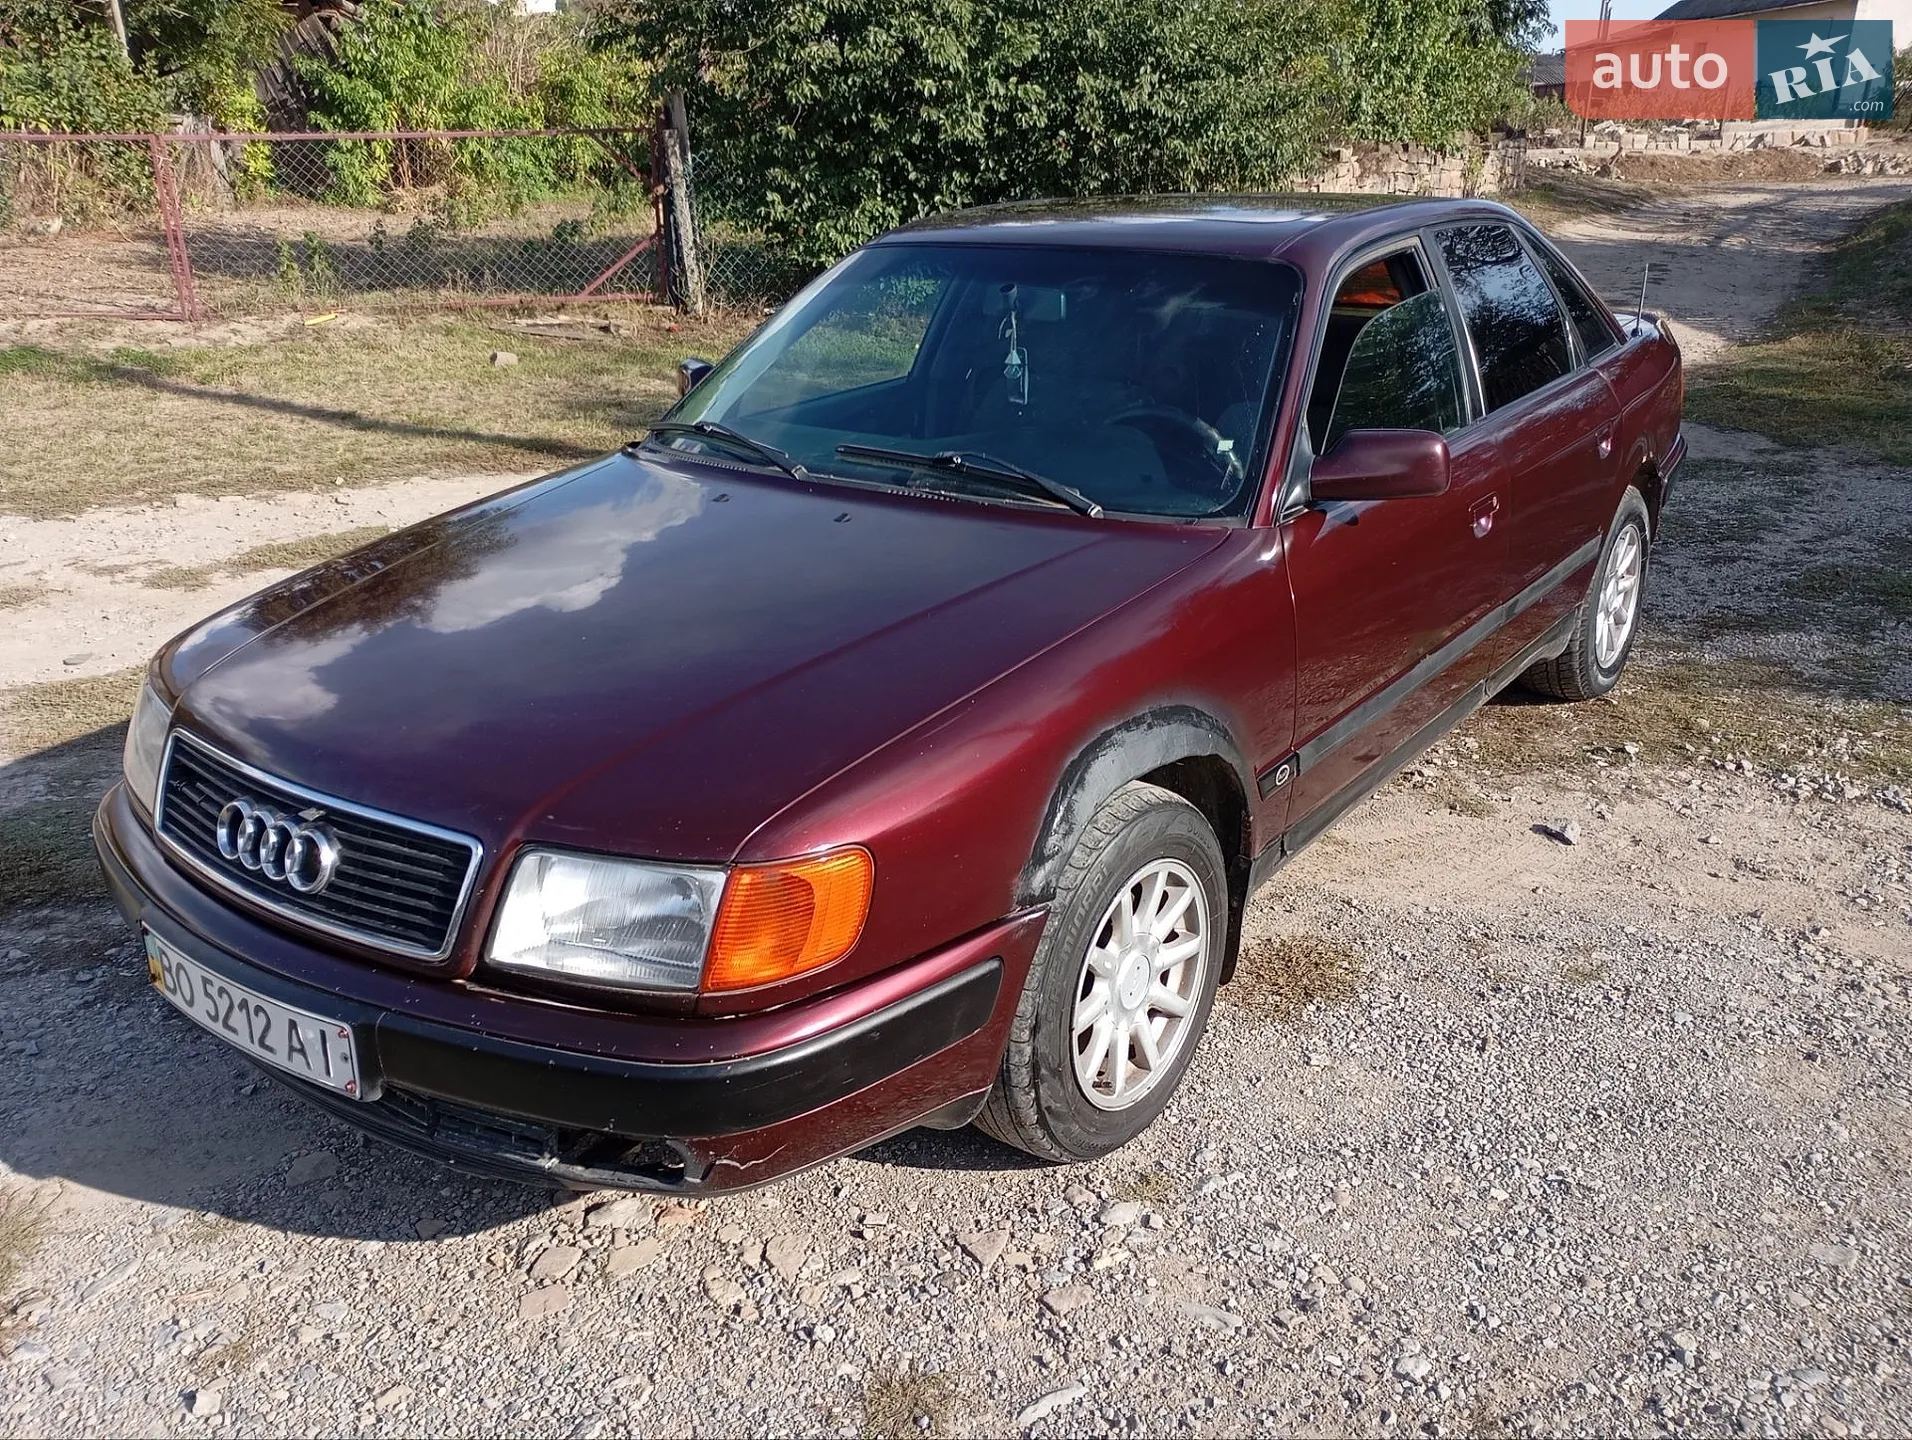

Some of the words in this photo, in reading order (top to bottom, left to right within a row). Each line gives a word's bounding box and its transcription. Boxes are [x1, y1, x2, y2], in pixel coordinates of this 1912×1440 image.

[157, 945, 195, 1009] BO
[201, 974, 277, 1056] 5212
[287, 1018, 334, 1079] AI
